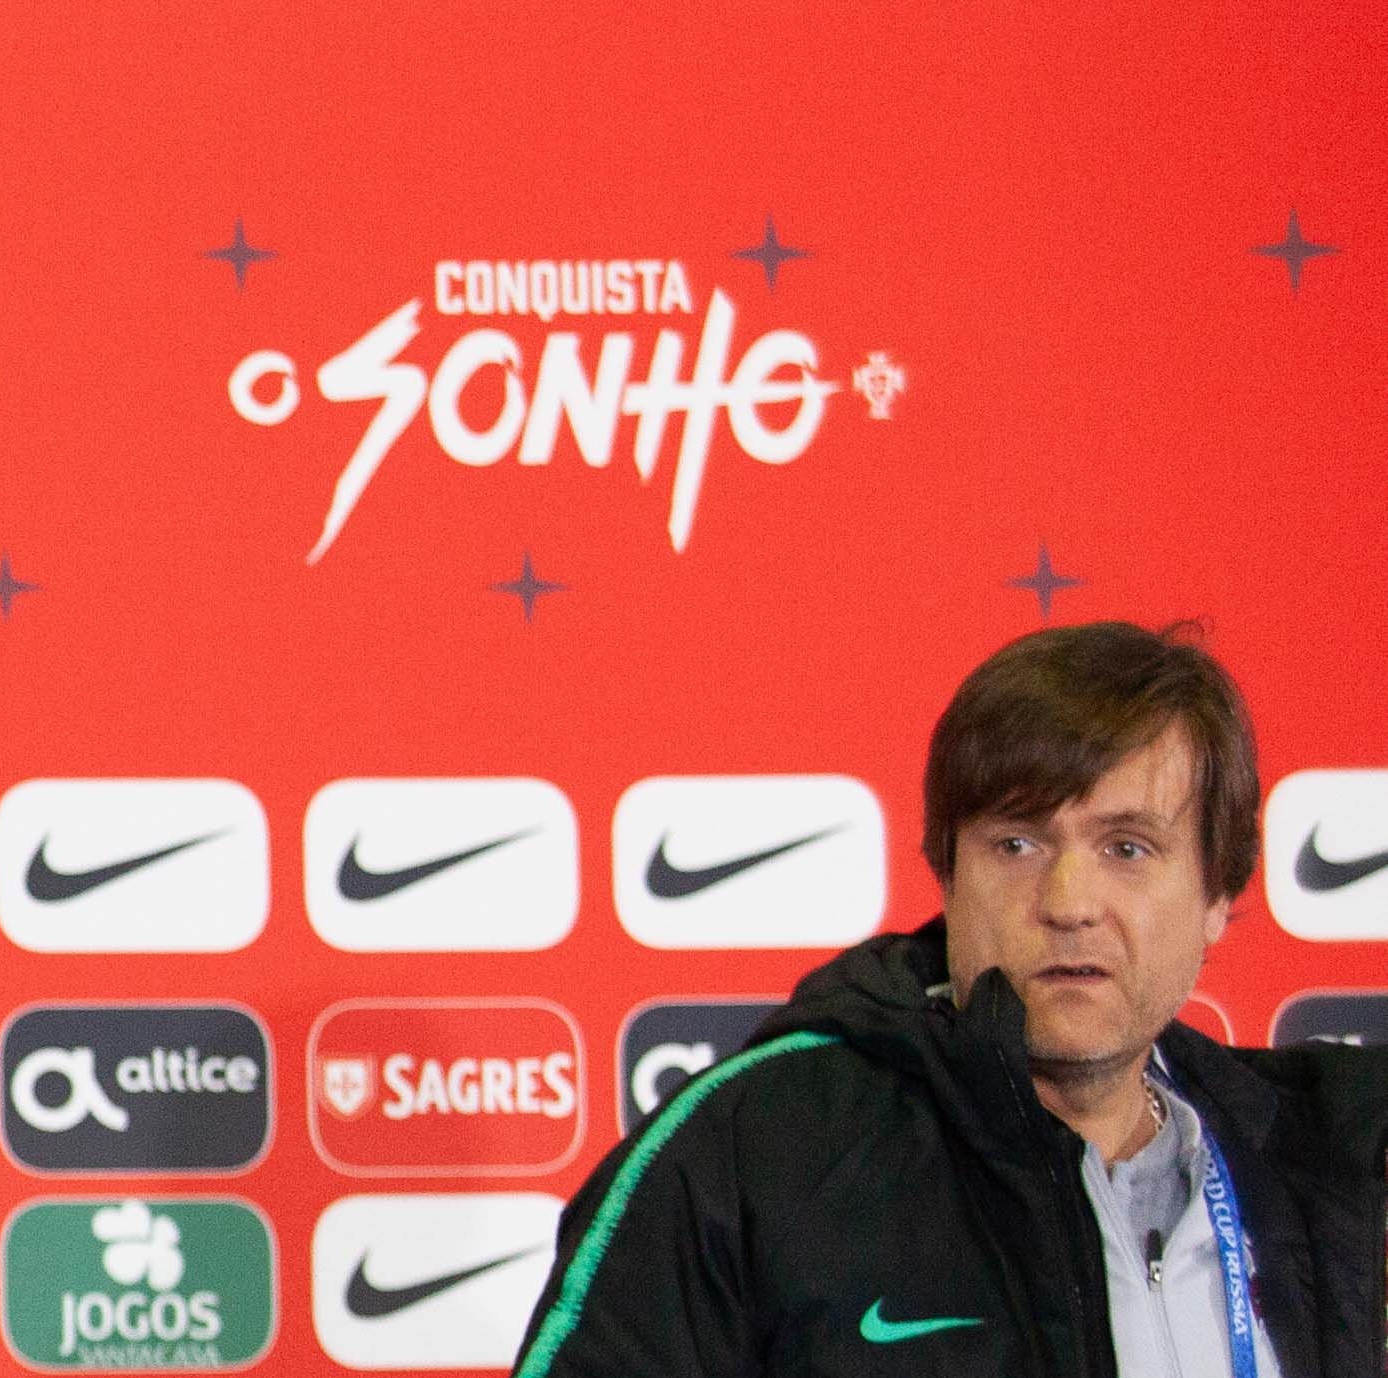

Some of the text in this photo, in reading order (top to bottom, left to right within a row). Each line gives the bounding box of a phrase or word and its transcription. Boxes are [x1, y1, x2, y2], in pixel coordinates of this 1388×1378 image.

[434, 258, 694, 322] CONQUISTA
[228, 350, 300, 426] O
[116, 1047, 258, 1093] altice
[383, 1050, 577, 1119] SAGRES
[60, 1289, 222, 1357] JOGOS
